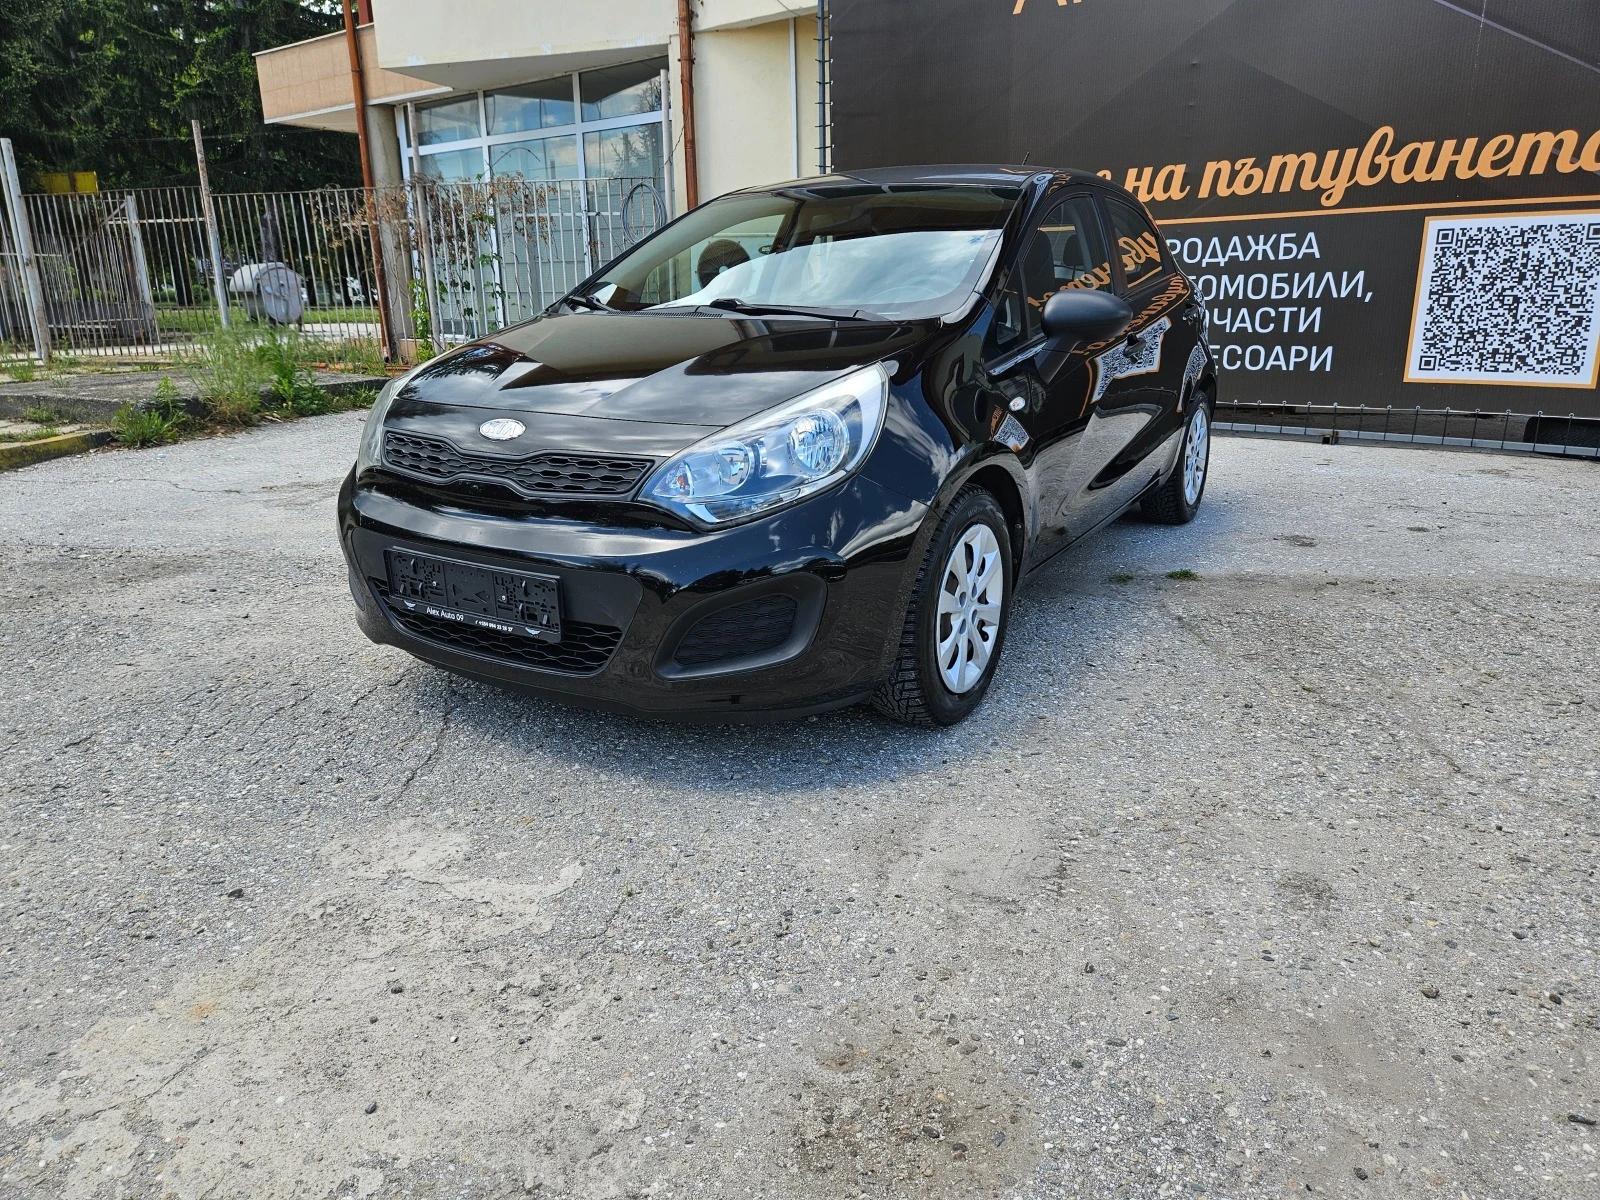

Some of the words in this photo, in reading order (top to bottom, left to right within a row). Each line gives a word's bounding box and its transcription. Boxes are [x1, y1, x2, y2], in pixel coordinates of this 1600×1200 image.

[1124, 163, 1190, 203] на
[1165, 231, 1321, 267] РОДАЖБА
[1189, 270, 1373, 303] ОМОБИЛИ,
[1205, 306, 1322, 333] ЧАСТИ
[426, 606, 440, 616] Alex
[440, 609, 456, 620] Auto
[455, 613, 464, 622] 09
